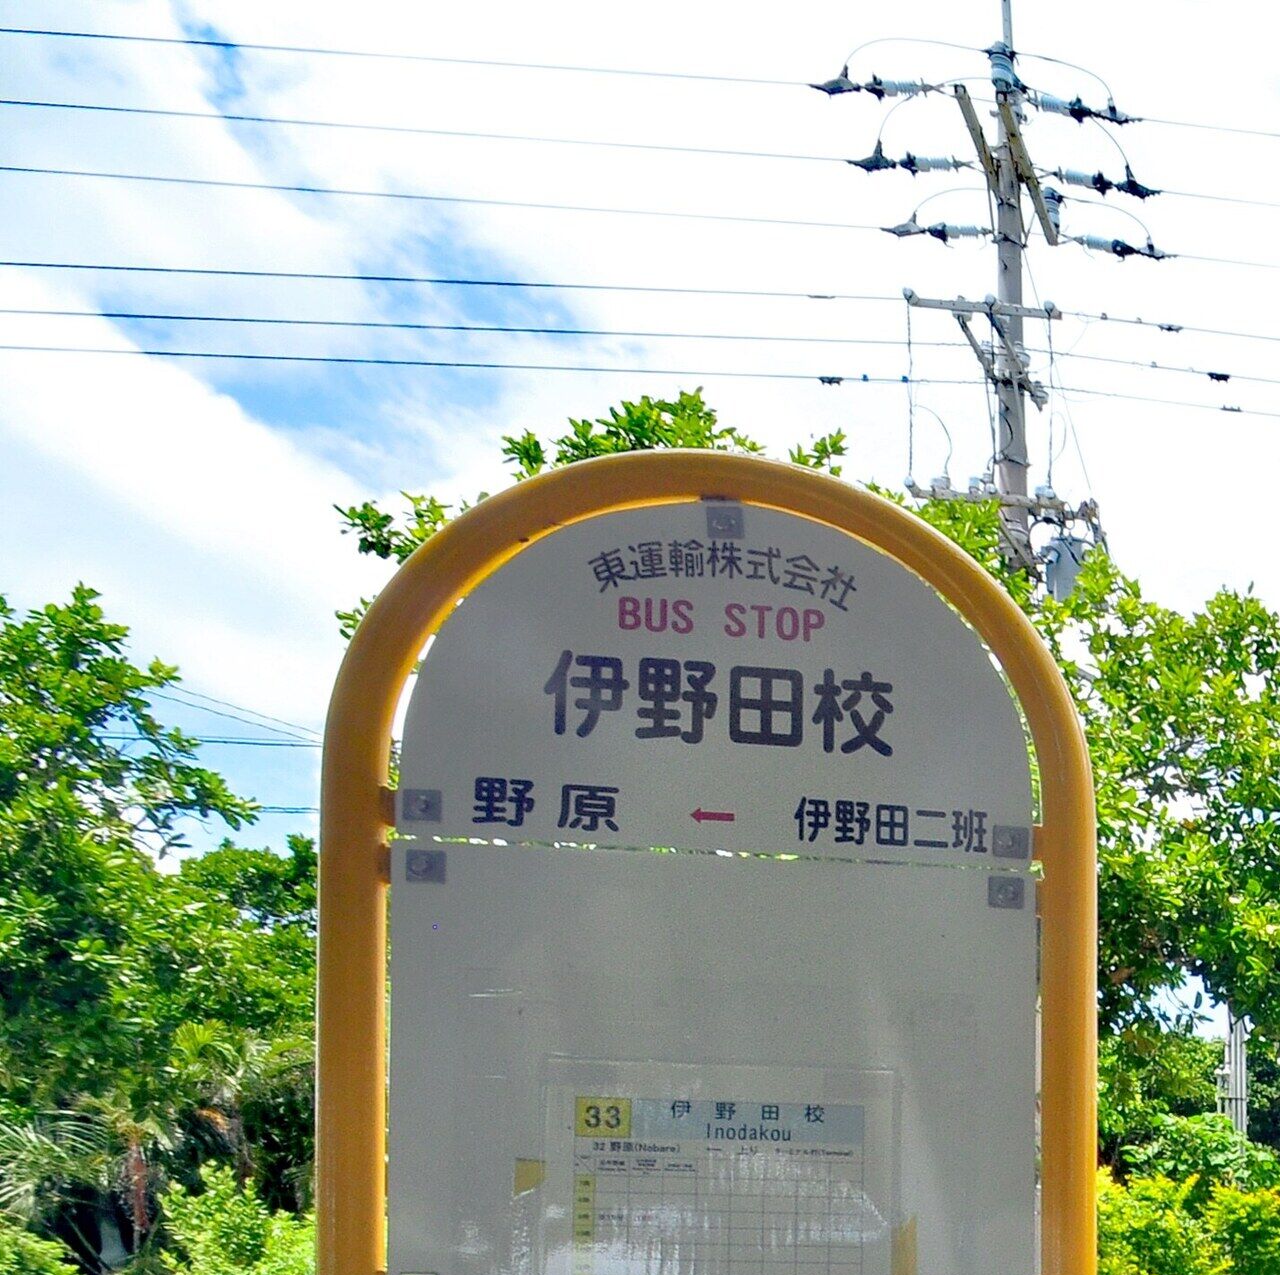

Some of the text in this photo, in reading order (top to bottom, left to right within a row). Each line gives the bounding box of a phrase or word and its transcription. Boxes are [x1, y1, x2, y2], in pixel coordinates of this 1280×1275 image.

[588, 539, 858, 612] 東運輸株式会社
[617, 596, 825, 642] BUS STOP
[543, 649, 894, 757] 伊野田校
[794, 796, 989, 854] 伊野田二班
[584, 1105, 620, 1129] 33
[705, 1123, 791, 1141] Inodakou
